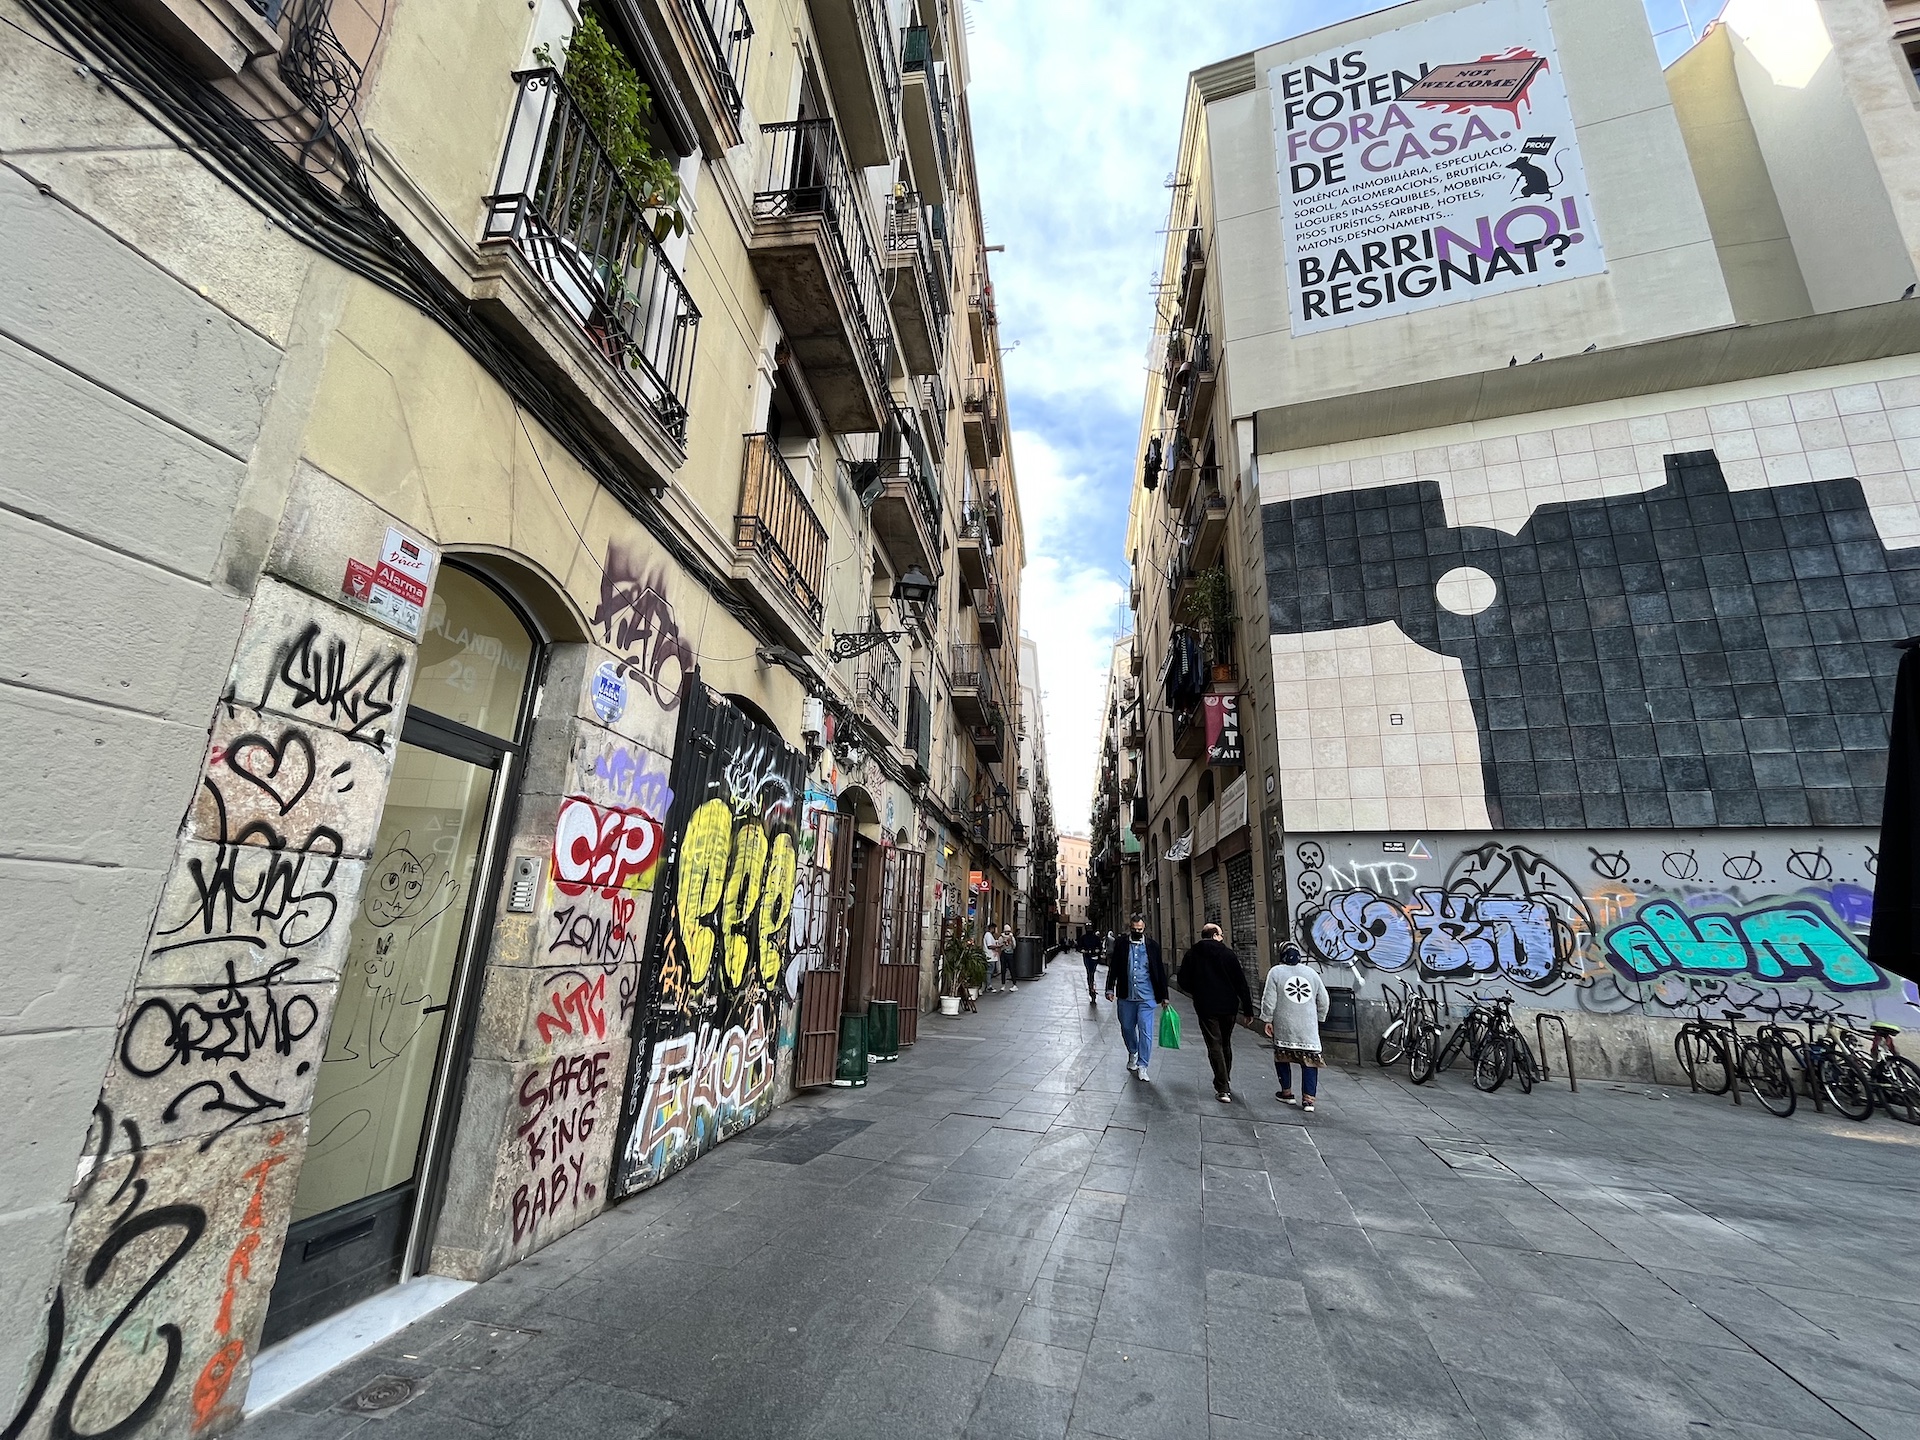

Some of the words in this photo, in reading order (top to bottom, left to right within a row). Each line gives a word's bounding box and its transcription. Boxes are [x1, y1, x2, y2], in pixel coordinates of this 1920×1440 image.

[1281, 51, 1367, 100] ENS
[1285, 63, 1432, 130] FOTEN
[1420, 78, 1517, 89] WELCOME
[1456, 69, 1496, 78] NOT
[1287, 104, 1415, 161] FORA
[1290, 153, 1346, 194] DE
[1360, 115, 1511, 173] CASA.
[1293, 187, 1349, 207] VIOLÈNCIA
[1352, 166, 1432, 192] INMOBILIÀRIA,
[1435, 143, 1517, 170] ESPECULACIÓ,
[1294, 203, 1338, 219] SOROLL,
[1340, 175, 1443, 207] AGLOMERACIONS,
[1446, 160, 1502, 180] BRUTÍCIA,
[1295, 210, 1349, 230] LLOGUERS
[1351, 188, 1440, 216] INASSEQUIBLES,
[1444, 172, 1506, 193] MOBBING,
[1296, 227, 1327, 241] PISOS
[1330, 214, 1385, 233] TURÍSTICS,
[1388, 202, 1434, 219] AIRBNB,
[1437, 189, 1485, 206] HOTELS,
[1299, 230, 1434, 288] BARRI
[1434, 196, 1584, 263] NO!
[1303, 233, 1571, 321] RESIGNAT?
[379, 567, 424, 597] Alarma
[1222, 695, 1238, 746] CNT
[1222, 749, 1240, 759] AIT
